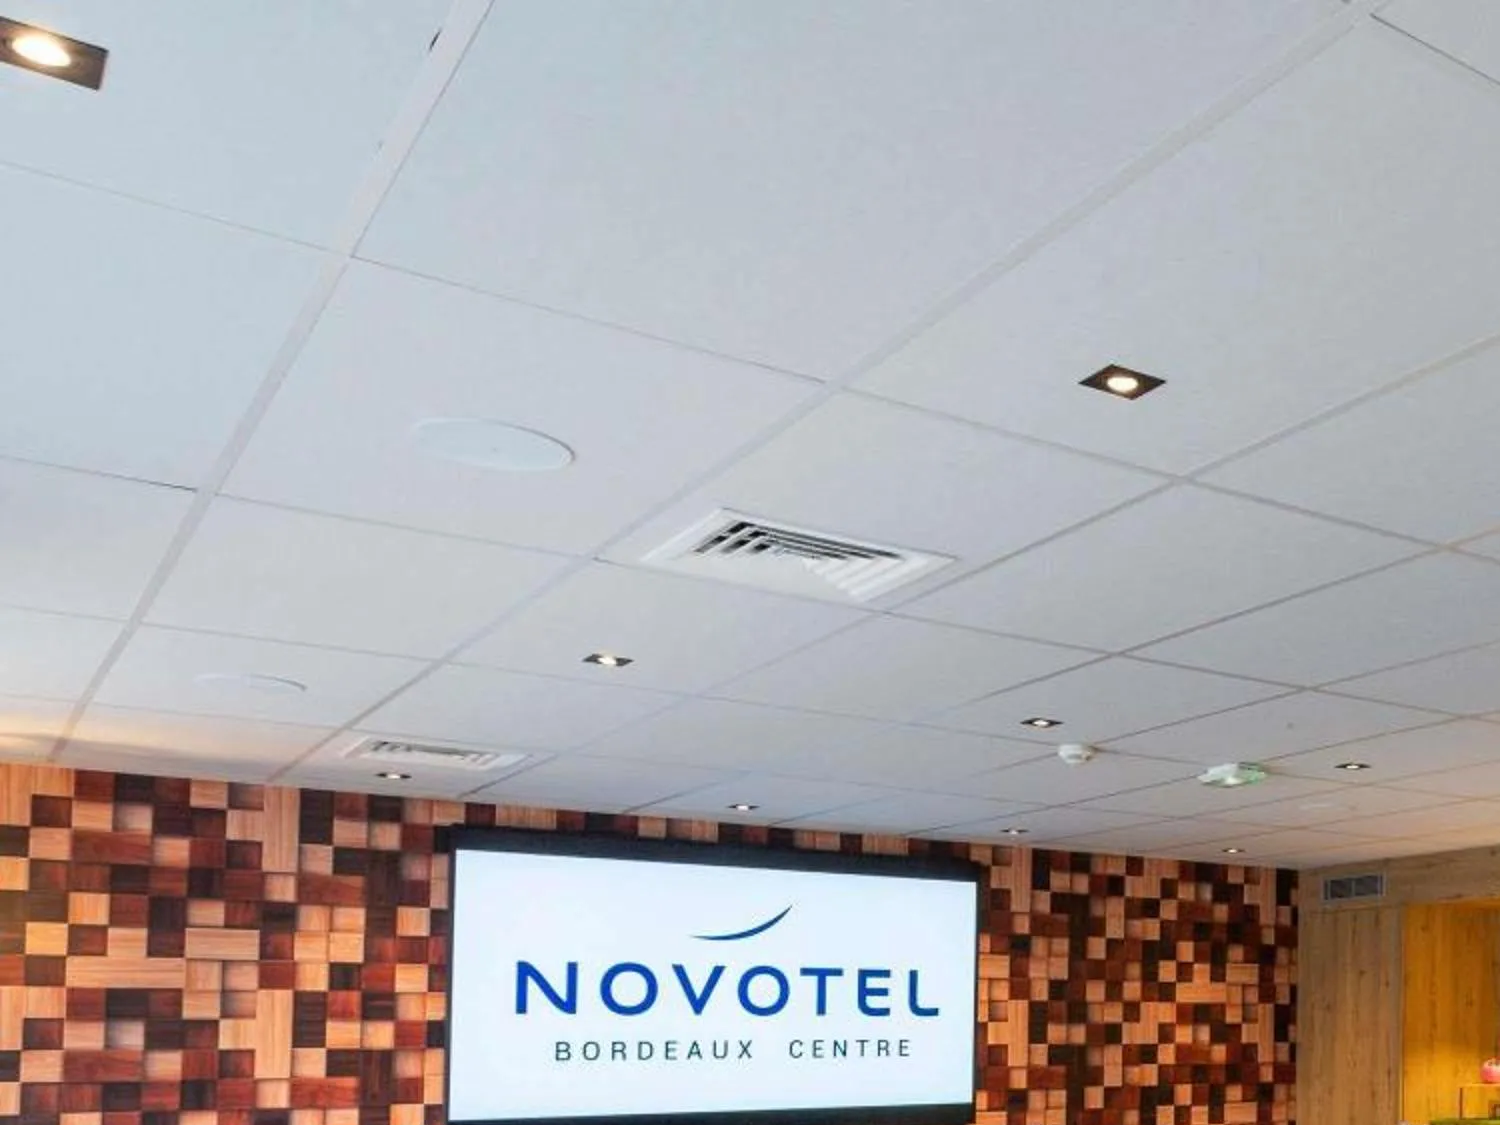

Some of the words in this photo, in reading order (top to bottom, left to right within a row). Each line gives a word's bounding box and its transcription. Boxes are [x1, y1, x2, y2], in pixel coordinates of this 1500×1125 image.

[515, 961, 940, 1017] NOVOTEL
[554, 1040, 753, 1062] BORDEAUX
[788, 1039, 911, 1060] CENTRE
